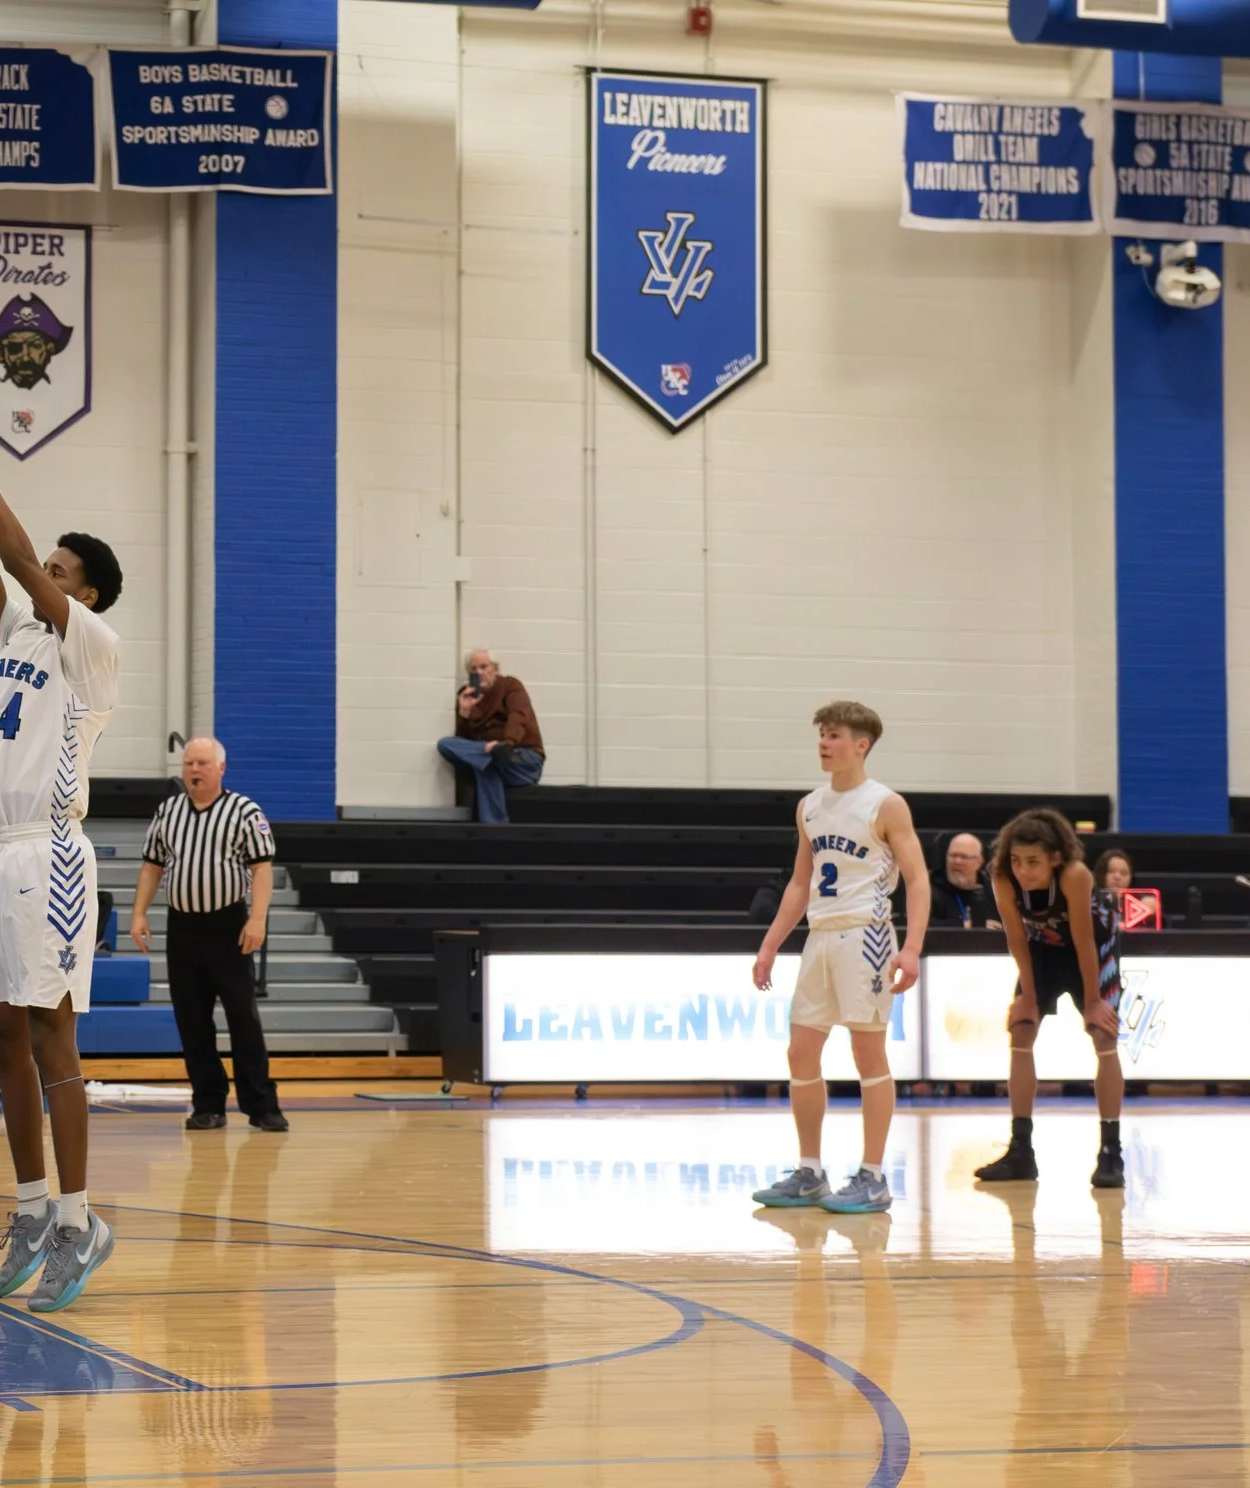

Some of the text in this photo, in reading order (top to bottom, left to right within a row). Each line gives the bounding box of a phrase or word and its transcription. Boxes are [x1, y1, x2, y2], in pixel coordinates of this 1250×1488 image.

[138, 63, 299, 88] BOYS BASKETBALL
[150, 94, 236, 114] 6A STATE
[602, 91, 751, 134] LEAVENWORTH
[1002, 104, 1061, 136] ANGELS
[264, 128, 319, 148] AWARD
[626, 129, 728, 176] Pioneers
[997, 135, 1039, 164] TEAM
[198, 154, 246, 174] 2007
[913, 161, 1080, 195] NATIONAL CHAMPIONS
[978, 192, 1018, 220] 2021
[818, 862, 838, 897] 2
